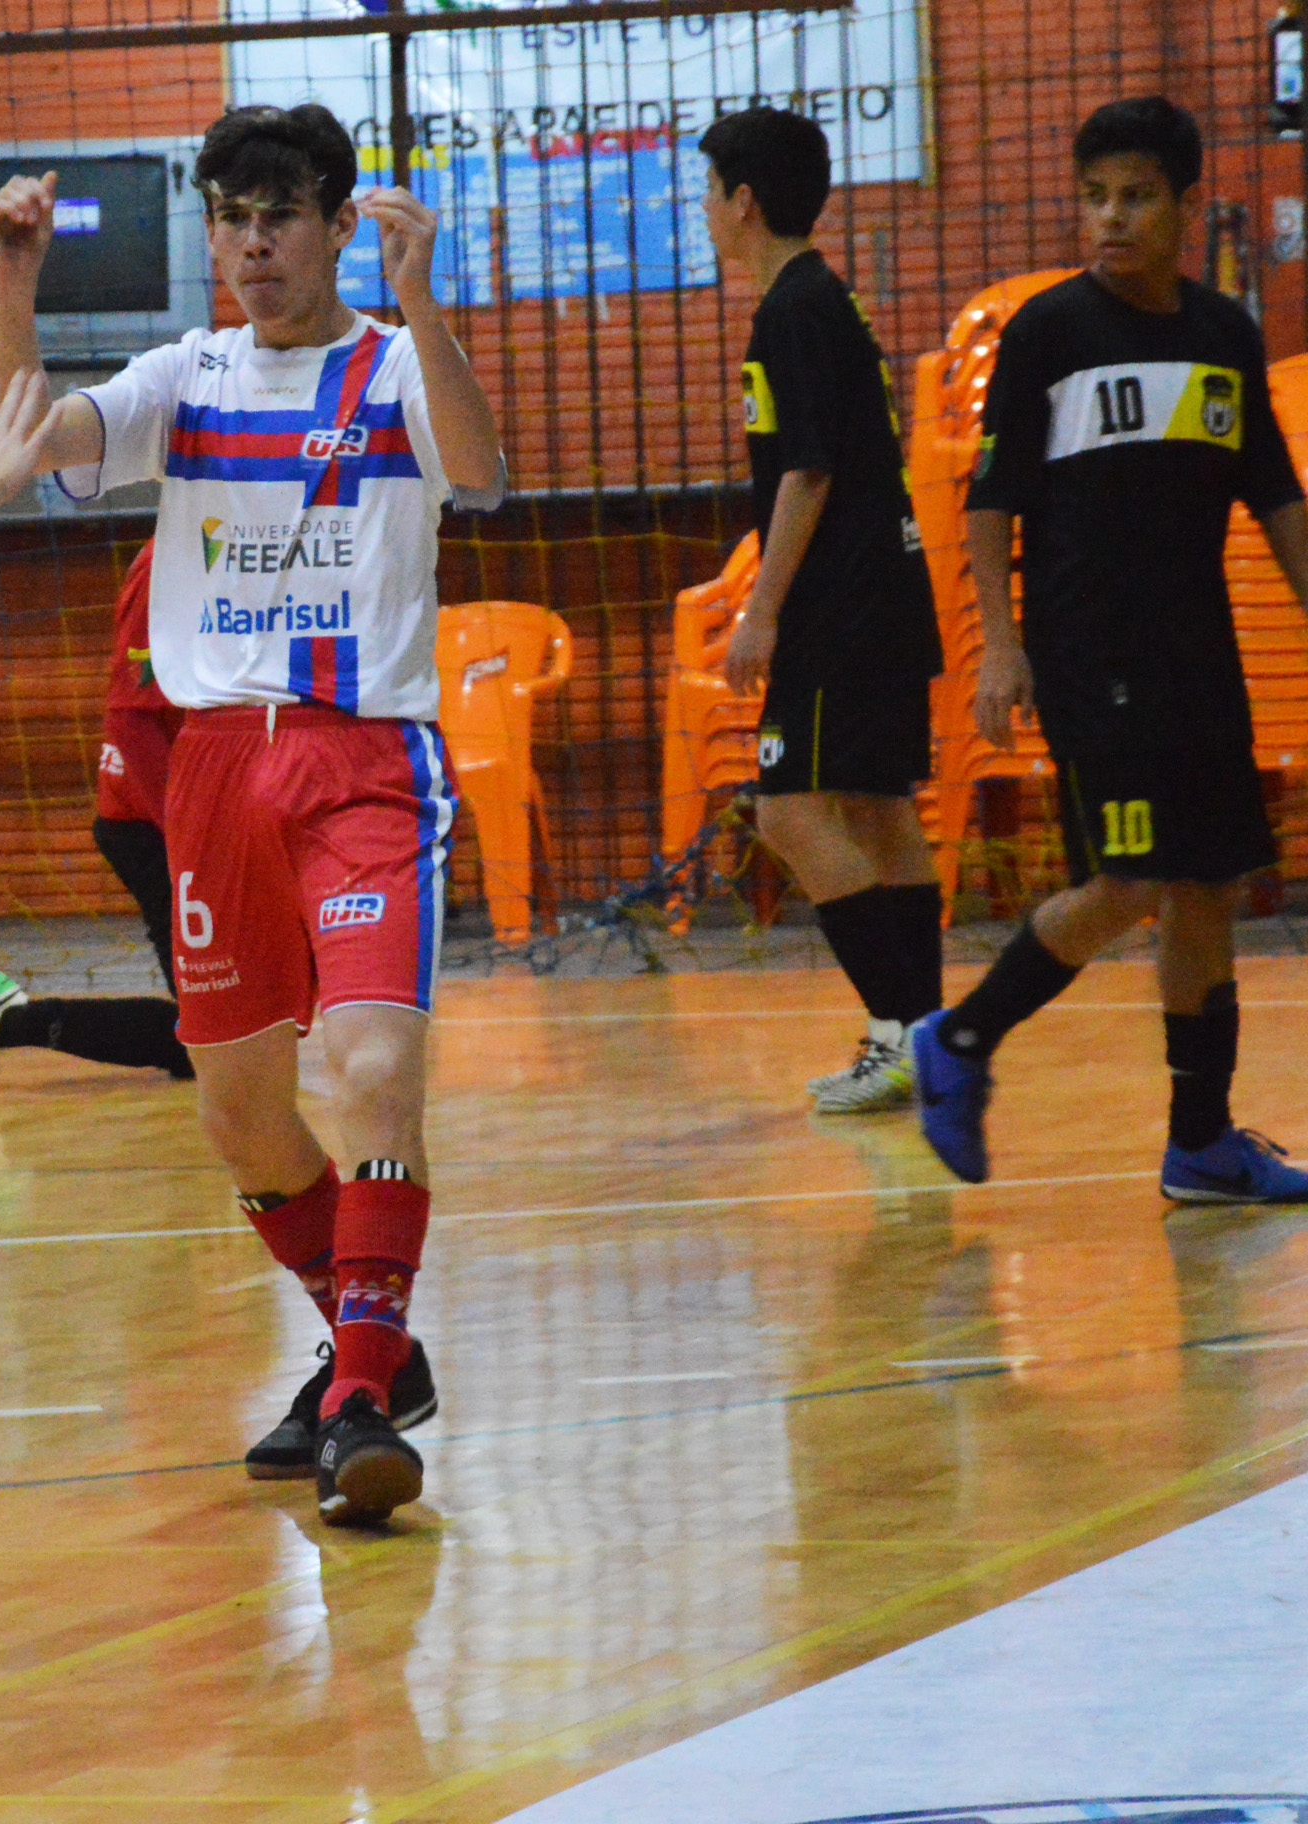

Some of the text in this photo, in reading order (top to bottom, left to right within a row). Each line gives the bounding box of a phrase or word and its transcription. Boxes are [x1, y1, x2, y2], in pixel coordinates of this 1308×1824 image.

[1095, 375, 1145, 437] 10
[1103, 799, 1154, 857] 10
[178, 870, 214, 950] 6
